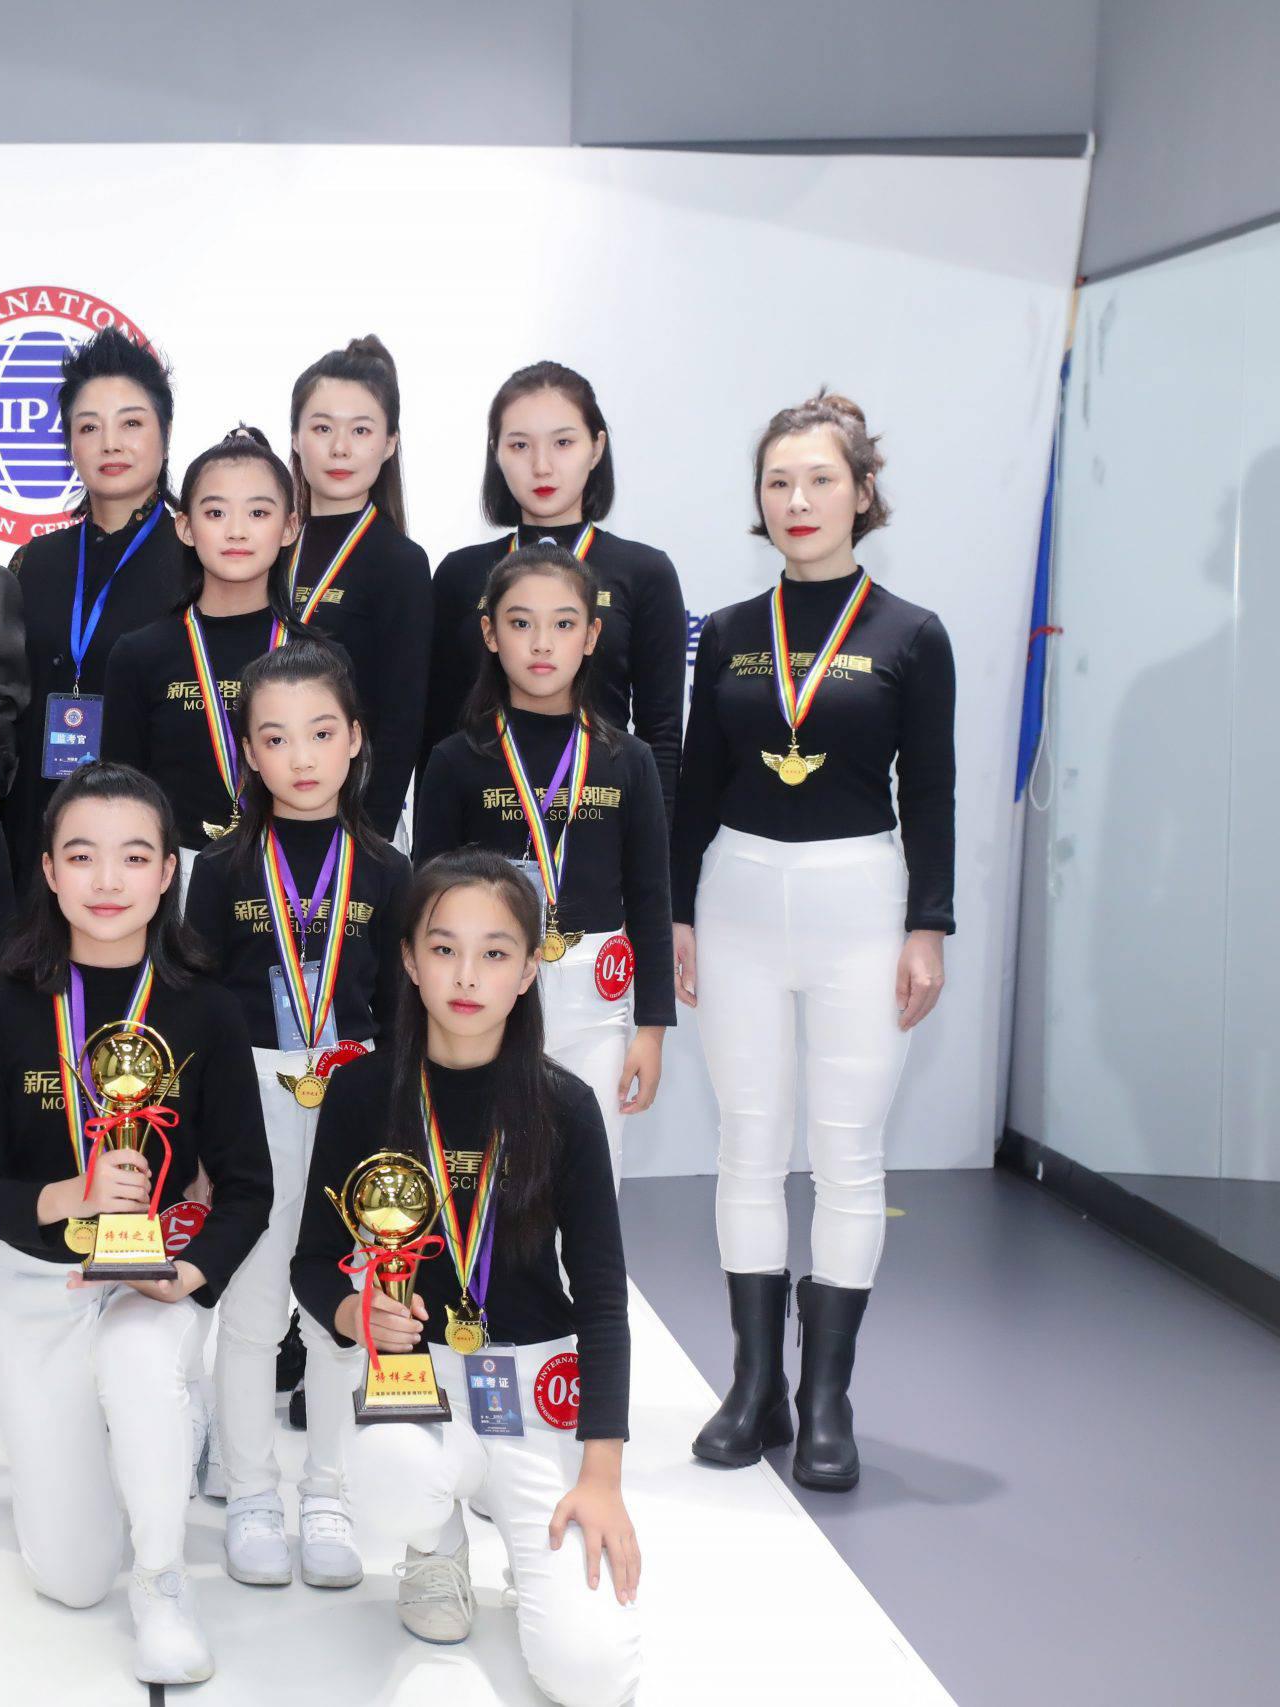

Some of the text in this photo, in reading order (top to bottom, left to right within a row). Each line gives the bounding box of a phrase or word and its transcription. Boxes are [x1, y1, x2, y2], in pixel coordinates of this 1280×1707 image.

[736, 665, 854, 681] MODESCOOL
[183, 699, 239, 711] MOLS
[501, 808, 605, 821] MOSCOOL
[252, 921, 362, 938] MOELSCOL
[598, 938, 634, 963] INTERNATIONAL
[602, 954, 627, 982] 04
[166, 1216, 195, 1251] 07
[547, 1375, 581, 1407] 08
